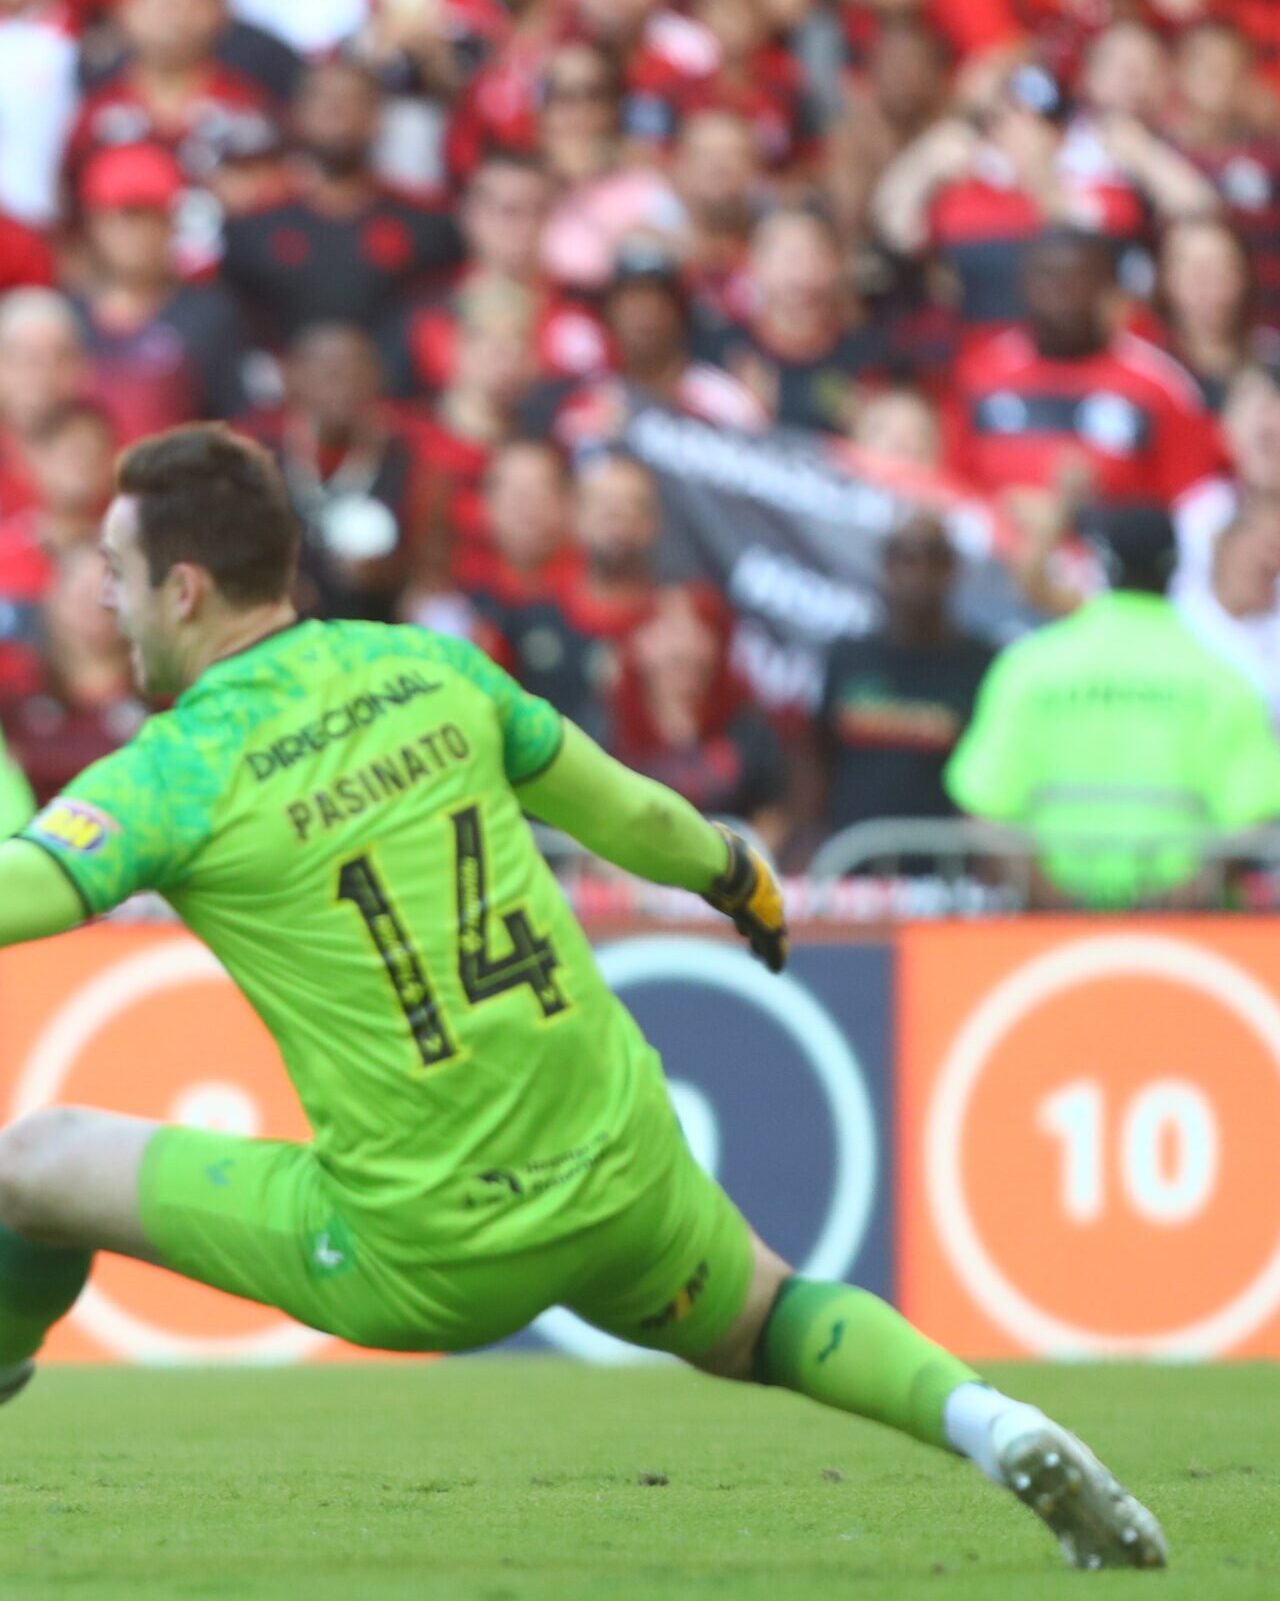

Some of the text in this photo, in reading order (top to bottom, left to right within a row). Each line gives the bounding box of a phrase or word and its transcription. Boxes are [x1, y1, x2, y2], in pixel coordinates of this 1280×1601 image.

[246, 672, 444, 782] DIRECIONAL
[286, 722, 471, 843] PASINATO
[337, 799, 571, 1070] 14
[1034, 1077, 1221, 1223] 10
